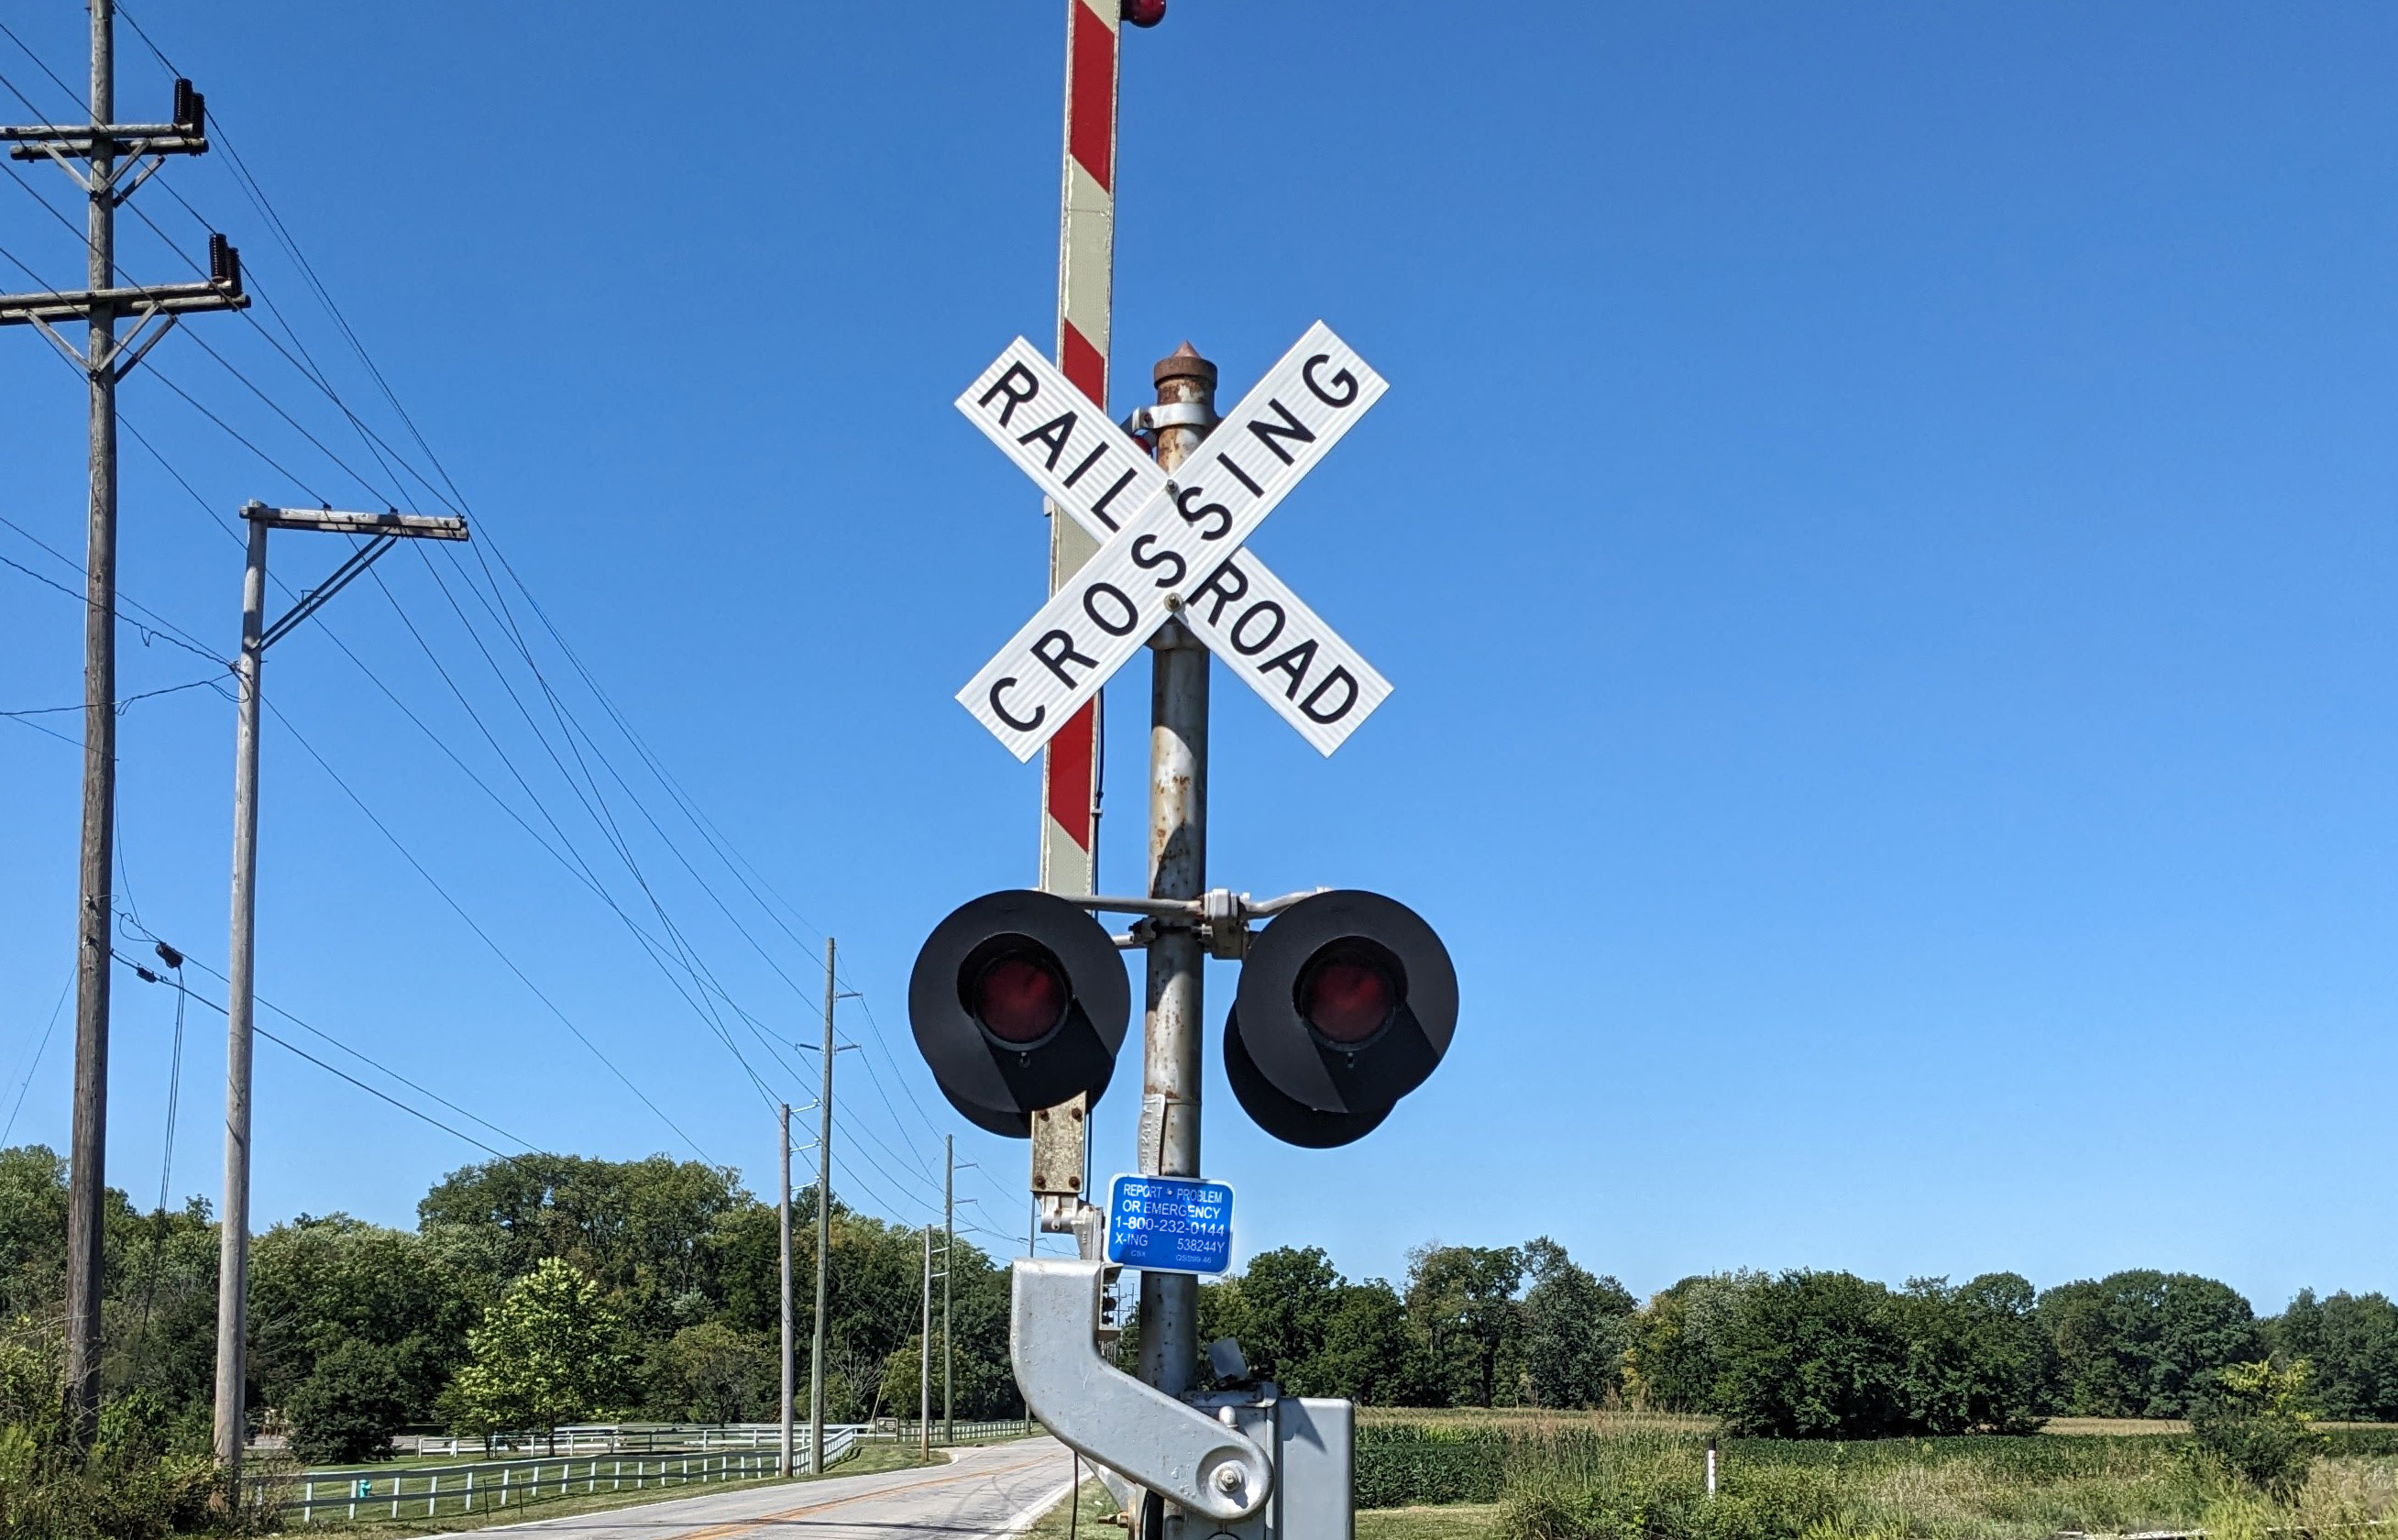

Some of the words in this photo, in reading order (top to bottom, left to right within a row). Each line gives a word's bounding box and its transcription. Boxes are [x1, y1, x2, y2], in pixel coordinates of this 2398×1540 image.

[977, 360, 1138, 534] RAIL
[1187, 557, 1359, 725] ROAD
[989, 354, 1359, 732] CROSSING
[1123, 1183, 1162, 1198] REPORT
[1176, 1188, 1223, 1204] PROBLEM
[1122, 1200, 1141, 1213] OR
[1143, 1201, 1222, 1219] EMERGENCY
[1115, 1216, 1225, 1237] 1-800-232-0144
[1115, 1232, 1148, 1246] X-ING
[1177, 1238, 1226, 1253] 538244Y
